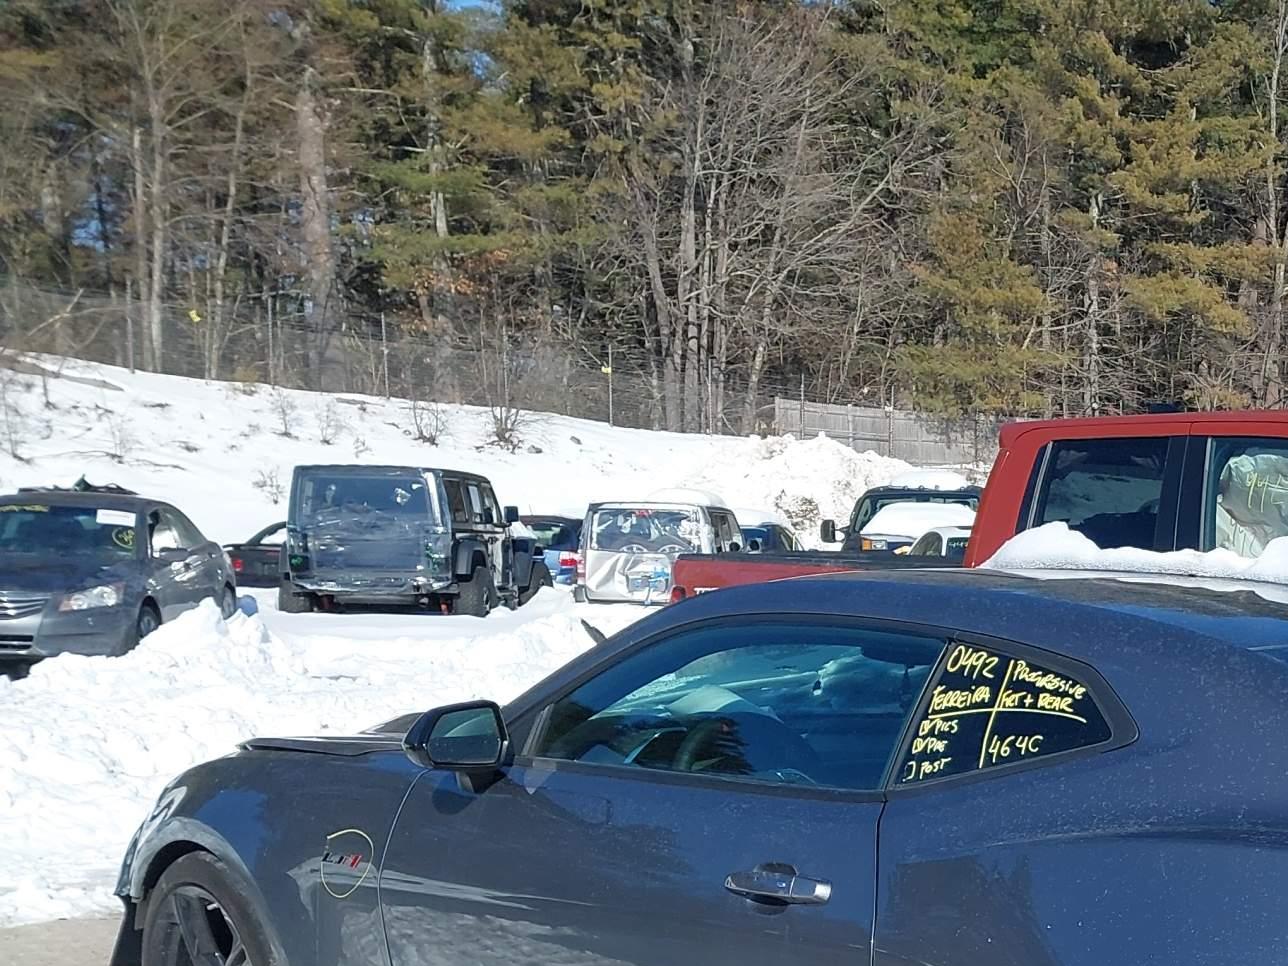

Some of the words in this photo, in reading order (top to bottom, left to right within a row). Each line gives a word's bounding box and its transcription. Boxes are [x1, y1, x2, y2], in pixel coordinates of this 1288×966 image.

[947, 645, 999, 680] 0492
[1037, 693, 1074, 712] REAR
[988, 735, 1044, 764] 464C
